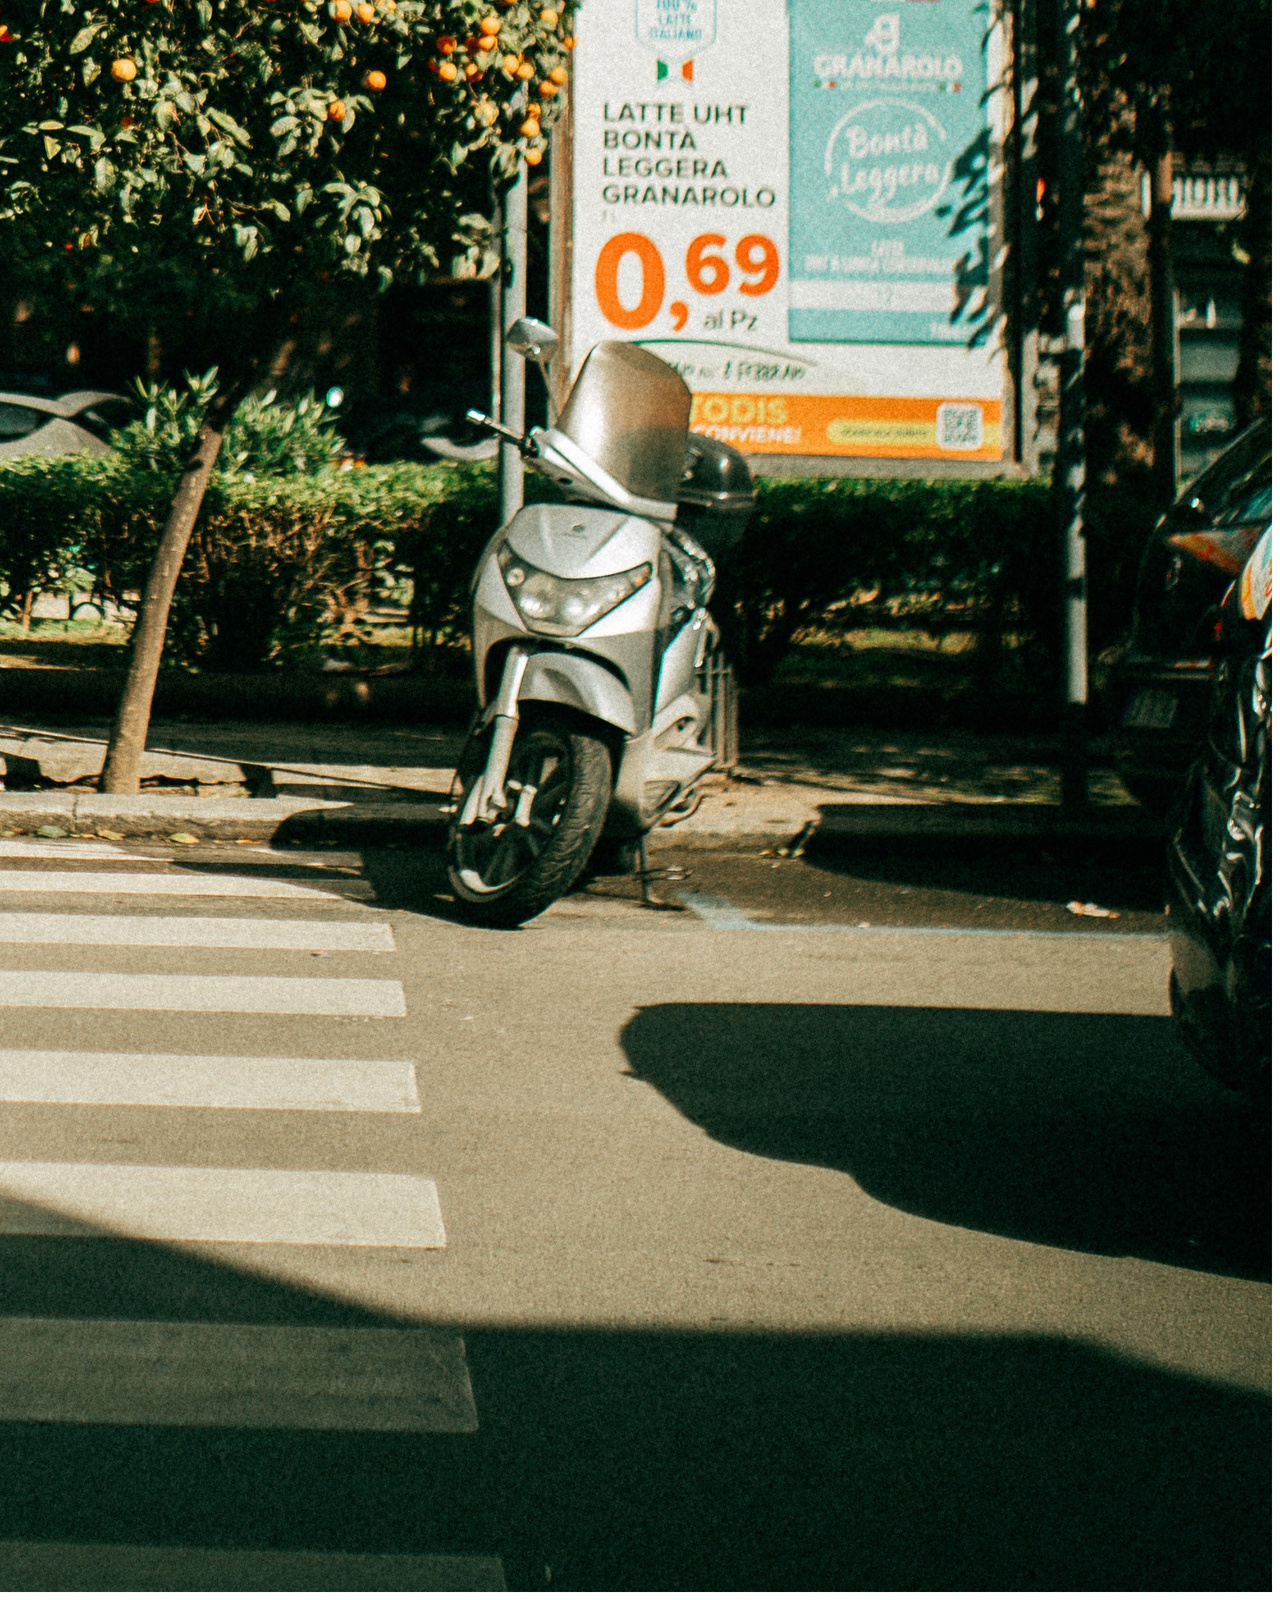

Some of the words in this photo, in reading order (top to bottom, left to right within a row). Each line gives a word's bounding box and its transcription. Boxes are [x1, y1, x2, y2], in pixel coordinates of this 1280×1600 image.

[814, 53, 964, 81] GRANAROLO
[602, 102, 685, 124] LATTE
[693, 104, 749, 126] UHT
[602, 127, 697, 151] BONTÀ
[844, 121, 929, 159] Bontà
[602, 157, 728, 179] LEGGERA
[601, 184, 777, 209] GRANAROLO
[841, 160, 940, 208] Leggera
[703, 309, 725, 331] al
[729, 309, 759, 333] Pz
[689, 396, 790, 426] TODIS
